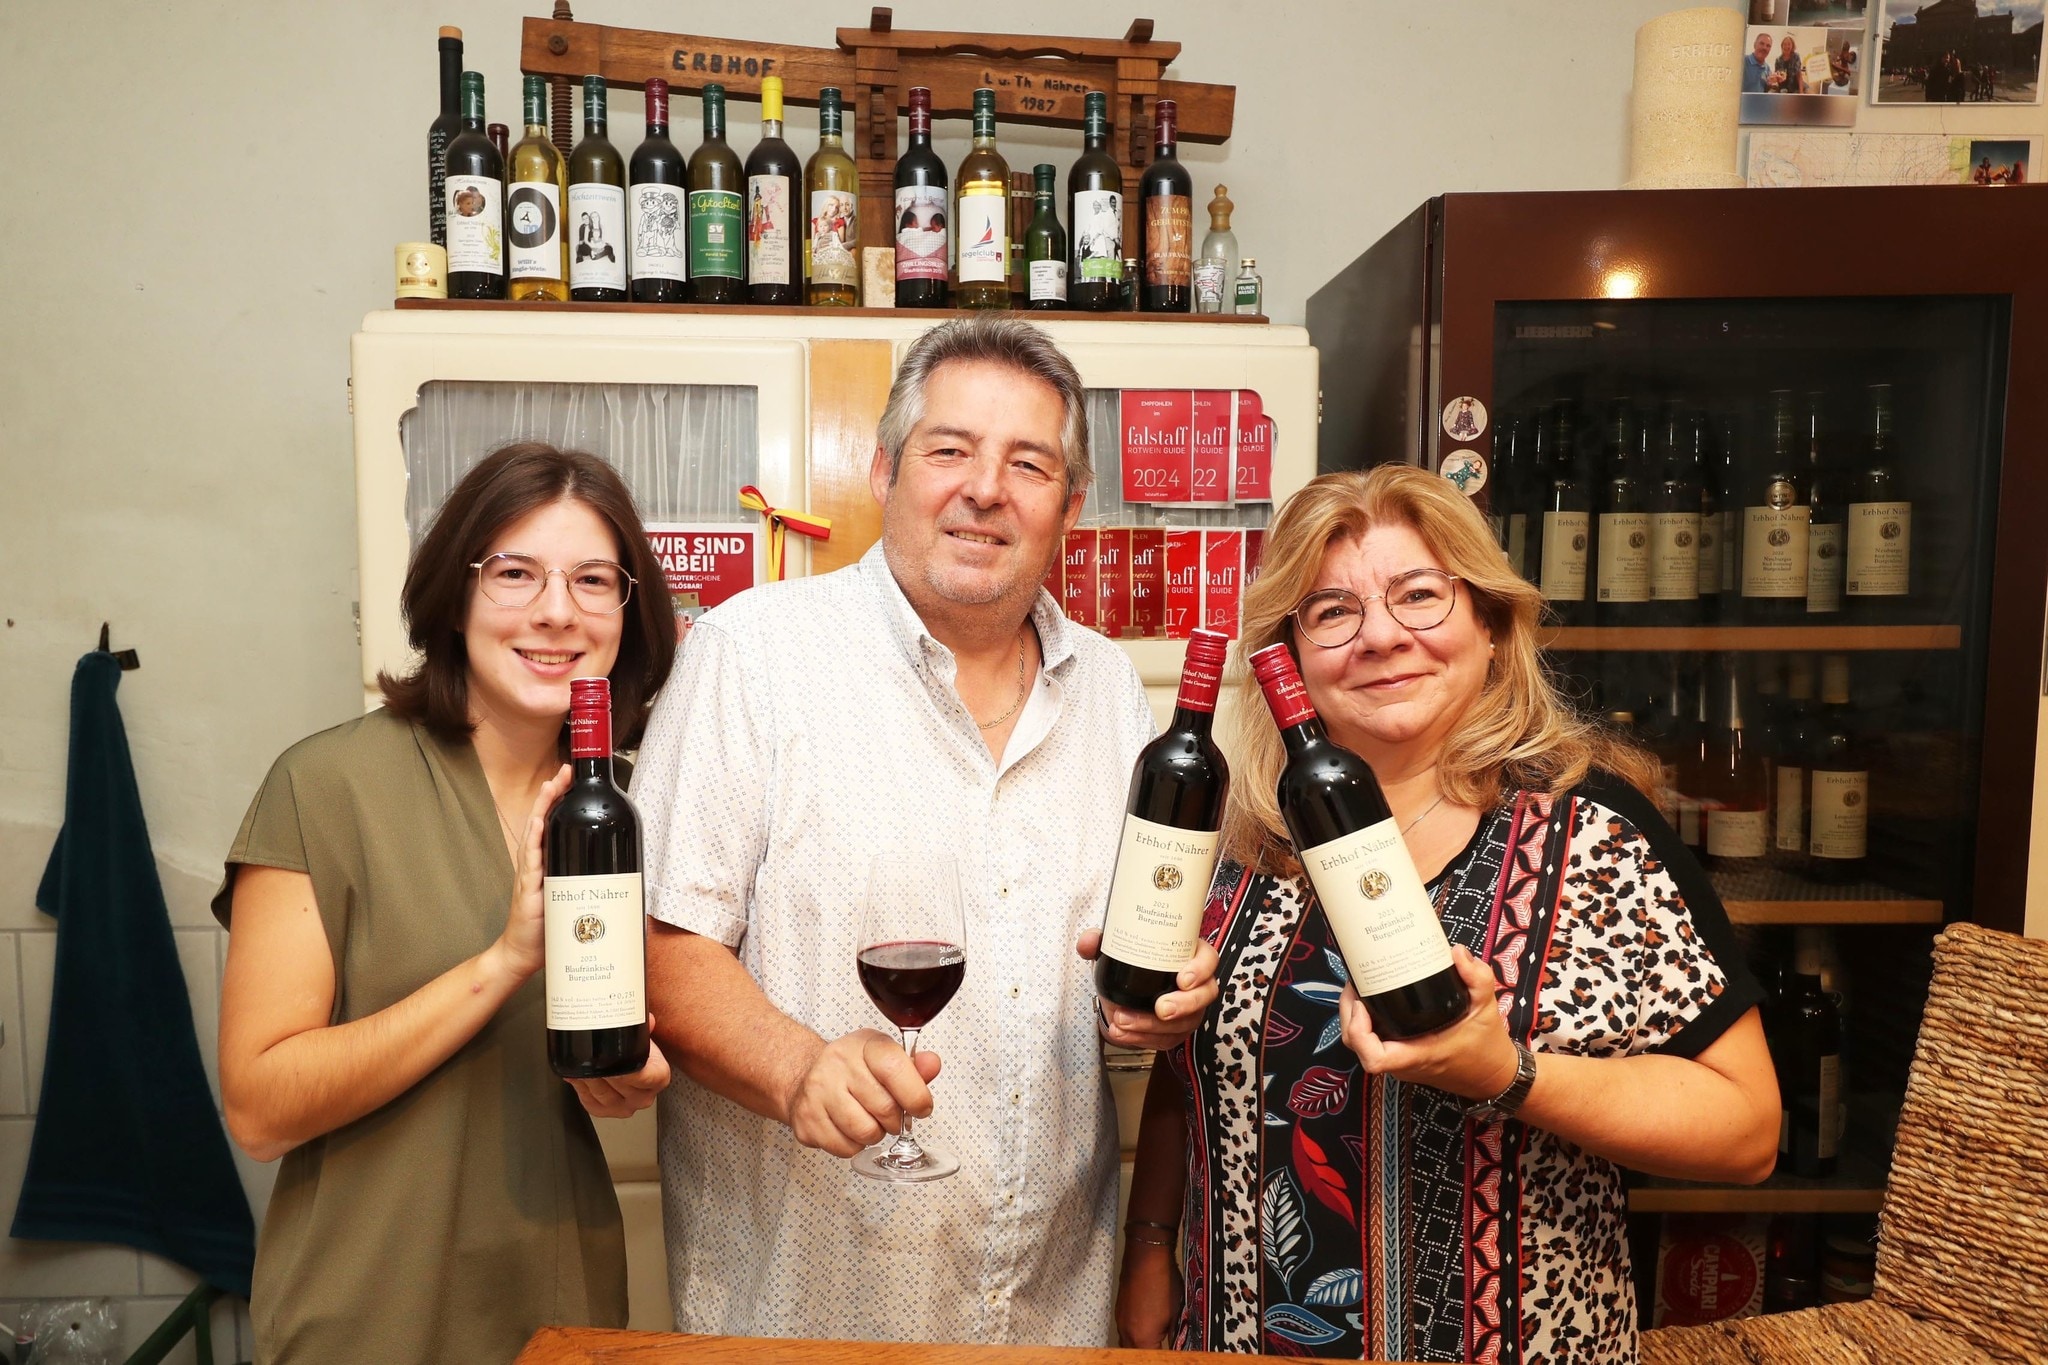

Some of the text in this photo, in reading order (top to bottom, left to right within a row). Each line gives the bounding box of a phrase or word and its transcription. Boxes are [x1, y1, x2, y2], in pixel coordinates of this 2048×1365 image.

[672, 50, 775, 77] ERBHOF
[1015, 75, 1032, 89] Th
[1044, 77, 1089, 94] Nährer
[1020, 96, 1056, 112] 1987
[708, 225, 724, 233] SV
[961, 250, 996, 259] segelclub
[1128, 426, 1189, 446] falstaff
[1127, 447, 1187, 455] ROTWEIN GUIDE
[1200, 447, 1224, 455] GUIDE
[1242, 444, 1265, 453] GUIDE
[1133, 468, 1180, 488] 2024
[1194, 468, 1217, 488] 22
[1237, 466, 1259, 485] 21
[1753, 514, 1778, 522] Erbhof
[1862, 508, 1890, 516] Erbhof
[1613, 518, 1637, 526] Erbhof
[1659, 518, 1683, 526] Erbhof
[647, 536, 746, 555] WIR SIND
[655, 554, 716, 573] ABEI!
[1171, 586, 1194, 594] GUIDE
[1210, 586, 1233, 595] GUIDE
[1166, 607, 1188, 627] 17
[1135, 832, 1209, 856] Erbhof Nährer
[1320, 836, 1398, 872] Erbhof Nährer
[551, 888, 629, 902] Erbhof Nährer
[1135, 905, 1183, 921] Blaufränkisch
[1152, 901, 1170, 909] 2023
[1137, 914, 1178, 929] Burgenland
[1364, 911, 1415, 936] Blaufränkisch
[1372, 922, 1415, 943] Burgenland
[565, 963, 615, 974] Blaufränkisch
[568, 972, 612, 983] Burgenland
[1690, 1255, 1706, 1297] Soda
[1701, 1244, 1720, 1310] CAMPARI
